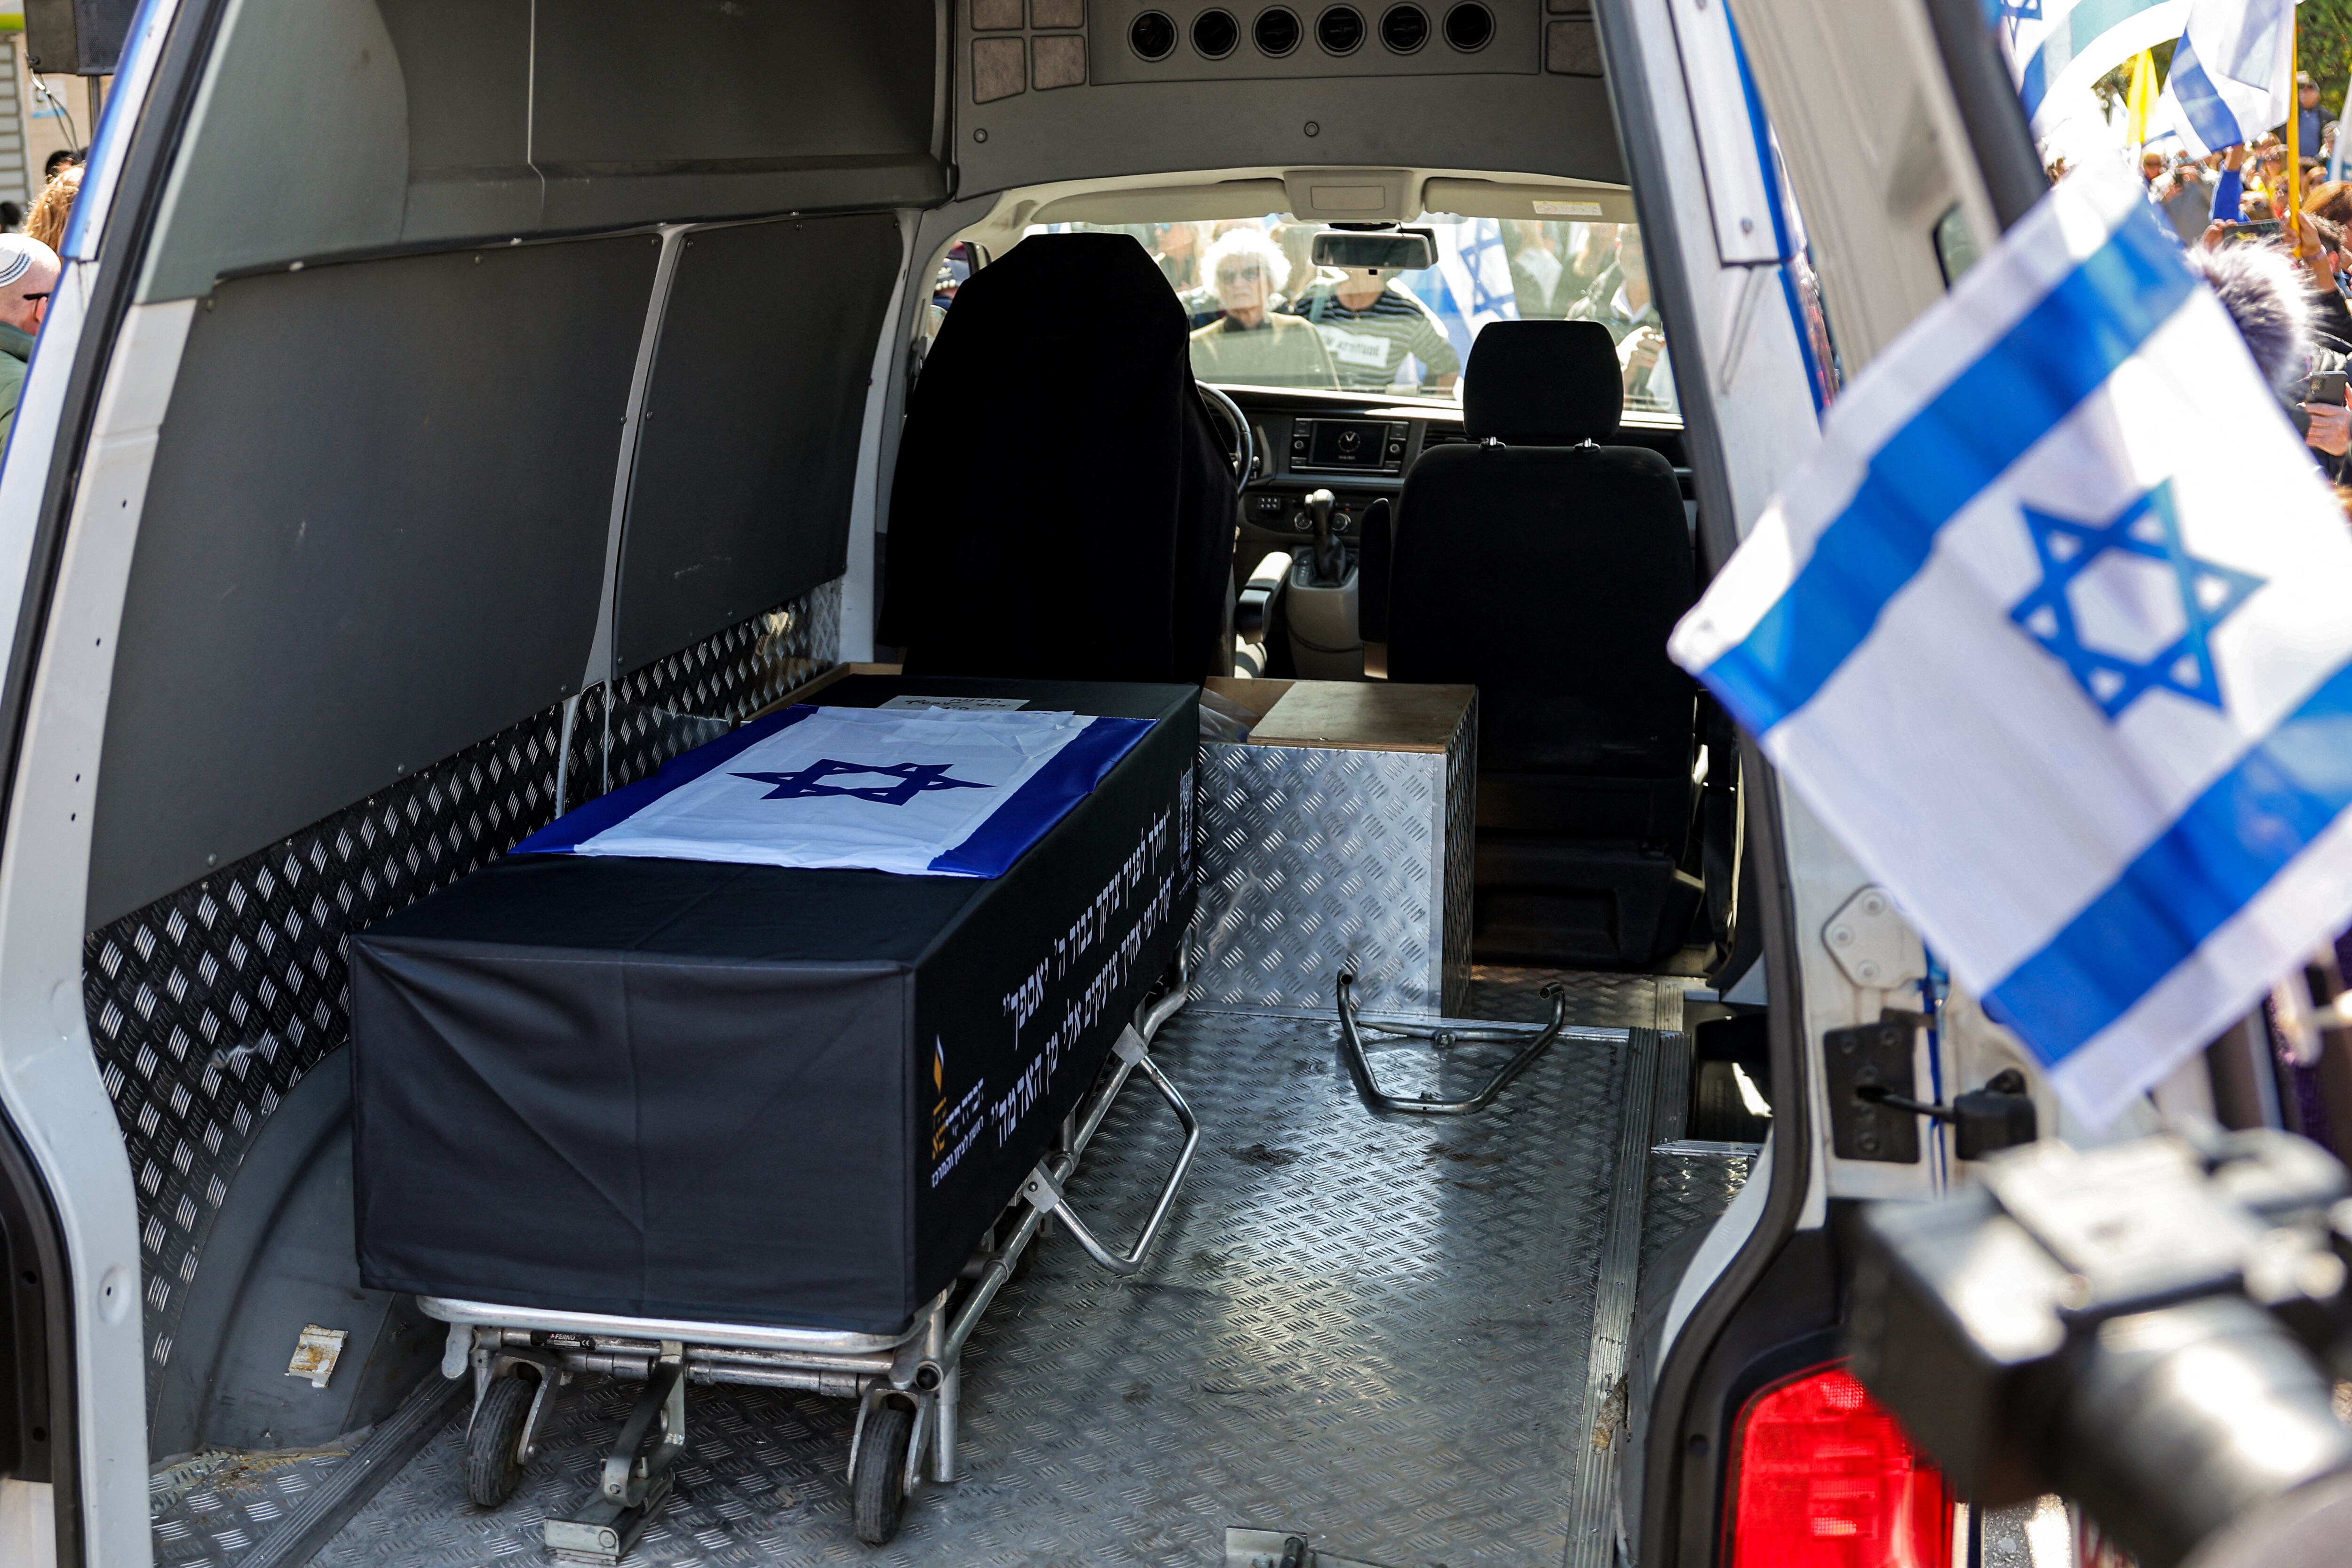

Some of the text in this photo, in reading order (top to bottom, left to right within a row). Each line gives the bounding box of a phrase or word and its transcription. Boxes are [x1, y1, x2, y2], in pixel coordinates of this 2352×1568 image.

[1124, 828, 1145, 909] לפניך
[1070, 906, 1092, 964] כבוד
[1097, 872, 1120, 944] צדקך
[1144, 898, 1157, 940] דמי
[1121, 919, 1141, 987] אחיך
[1085, 951, 1117, 1028] צועקים
[1063, 998, 1081, 1051] אלי
[1046, 1032, 1058, 1095] מן
[954, 1134, 969, 1165] לציון
[969, 1115, 984, 1146] ראשון
